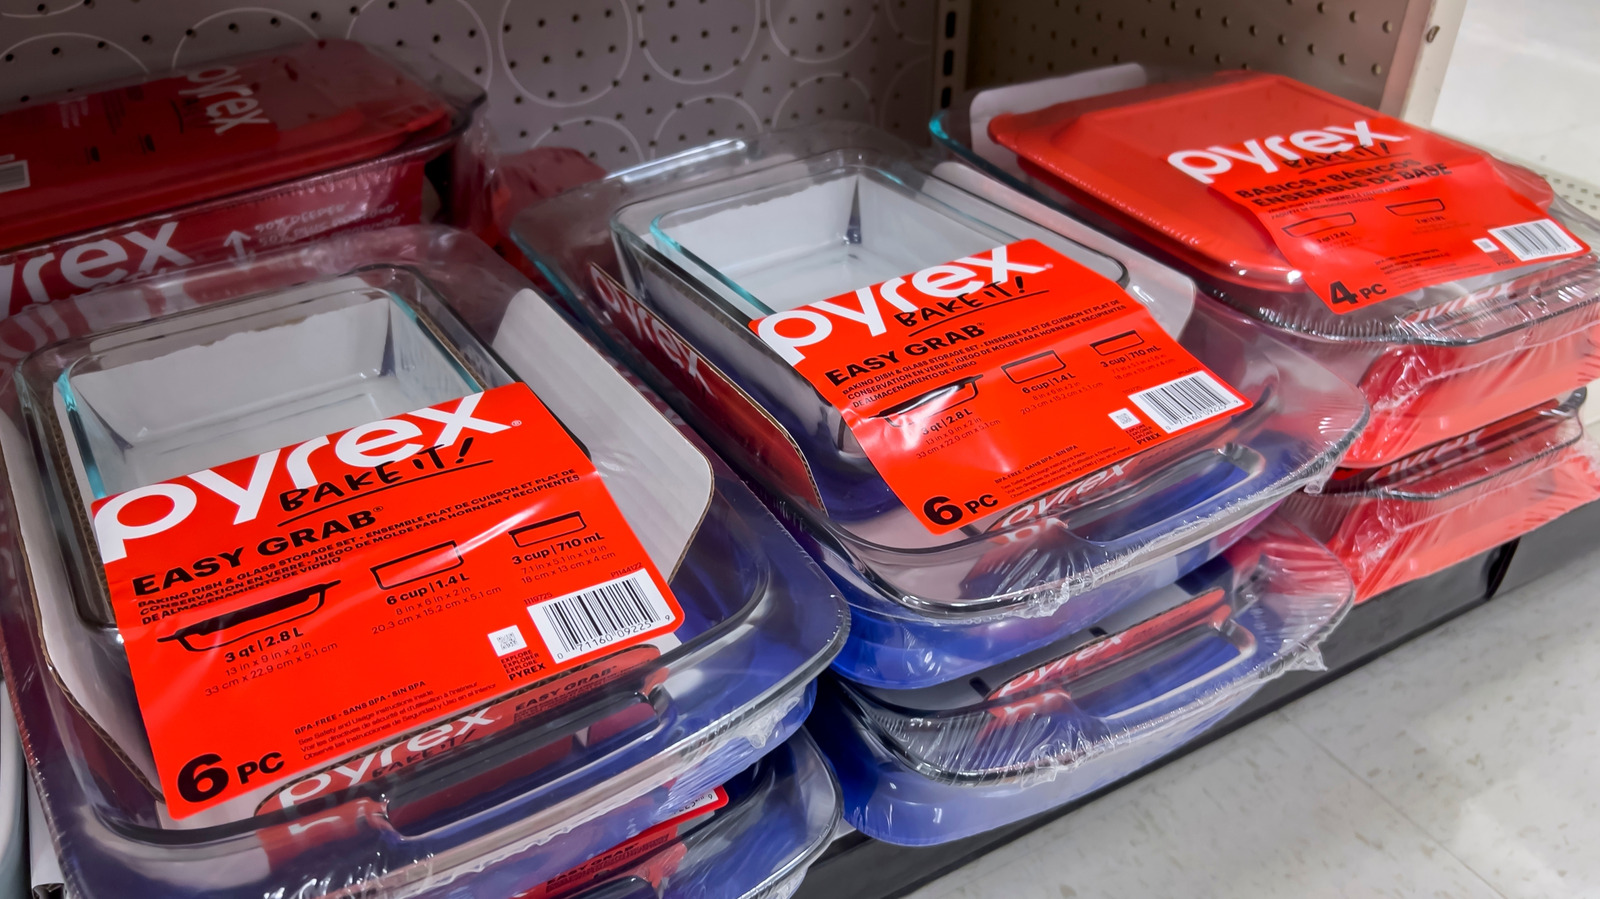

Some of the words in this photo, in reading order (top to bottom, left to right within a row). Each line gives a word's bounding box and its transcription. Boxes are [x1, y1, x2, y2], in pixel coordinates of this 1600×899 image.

[1167, 120, 1406, 185] pyrex
[1235, 179, 1317, 198] BASICS
[1251, 180, 1368, 206] ENSEMBLE
[1365, 174, 1399, 184] DE
[1396, 163, 1451, 180] BASE
[757, 245, 1047, 366] pyrex
[893, 292, 983, 327] BAKE
[983, 276, 1025, 298] IT!
[1329, 280, 1358, 305] 4
[1362, 283, 1387, 300] PC
[824, 350, 899, 386] EASY
[1108, 356, 1126, 365] cup
[1128, 349, 1146, 358] 710
[1146, 345, 1161, 353] mL
[1030, 382, 1050, 391] cup
[1052, 374, 1068, 383] 1.4
[1136, 432, 1161, 445] PYREX
[279, 460, 402, 512] BAKE
[412, 437, 474, 470] IT!
[923, 496, 963, 526] 6
[964, 494, 998, 514] PC
[137, 591, 189, 608] BAKING
[191, 580, 222, 595] DISH
[236, 563, 276, 580] GLASS
[278, 545, 329, 566] STORAGE
[335, 537, 355, 547] SET
[365, 516, 423, 538] ENSEMBLE
[426, 507, 451, 519] PLAT
[454, 502, 468, 510] DE
[470, 486, 518, 504] CUISSON
[534, 473, 558, 484] PLAT
[140, 582, 244, 616] CONSERVATION
[246, 575, 263, 585] EN
[265, 561, 304, 578] VERRE
[314, 546, 353, 562] JUEGO
[355, 540, 370, 548] DE
[372, 527, 413, 543] MOLDE
[415, 516, 446, 529] PARA
[447, 498, 502, 519] HORNEAR
[512, 474, 580, 498] RECIPIENTES
[512, 555, 522, 565] 3
[524, 549, 550, 561] cup
[556, 538, 581, 551] 710
[583, 532, 604, 544] mL
[132, 547, 244, 596] EASY
[386, 595, 397, 605] 6
[399, 587, 428, 601] cup
[436, 575, 458, 588] 1.4
[459, 573, 469, 581] L
[142, 613, 158, 625] DE
[162, 576, 280, 618] ALMACENAMIENTO
[282, 571, 298, 579] DE
[299, 556, 341, 573] VIDRIO
[225, 652, 236, 663] 3
[238, 644, 255, 657] qt
[264, 630, 291, 647] 2.8
[292, 627, 303, 637] L
[576, 633, 613, 652] 71160
[616, 618, 652, 638] 09225
[205, 685, 219, 696] 33
[221, 678, 239, 689] cm
[250, 664, 274, 679] 22.9
[276, 659, 294, 670] cm
[303, 648, 318, 659] 5.1
[320, 642, 338, 653] cm
[225, 667, 237, 676] 13
[239, 663, 250, 671] in
[260, 654, 269, 663] 9
[271, 652, 282, 660] in
[292, 644, 299, 653] 2
[301, 641, 311, 649] in
[500, 649, 531, 664] EXPLORE
[503, 653, 539, 669] EXPLORER
[505, 659, 536, 674] EXPLORE
[508, 663, 545, 681] PYREX
[294, 714, 336, 735] BPA-FREE
[343, 702, 367, 715] SANS
[368, 695, 386, 706] BPA
[391, 687, 407, 696] SIN
[407, 681, 425, 691] BPA
[177, 753, 229, 803] 6
[236, 752, 284, 784] PC
